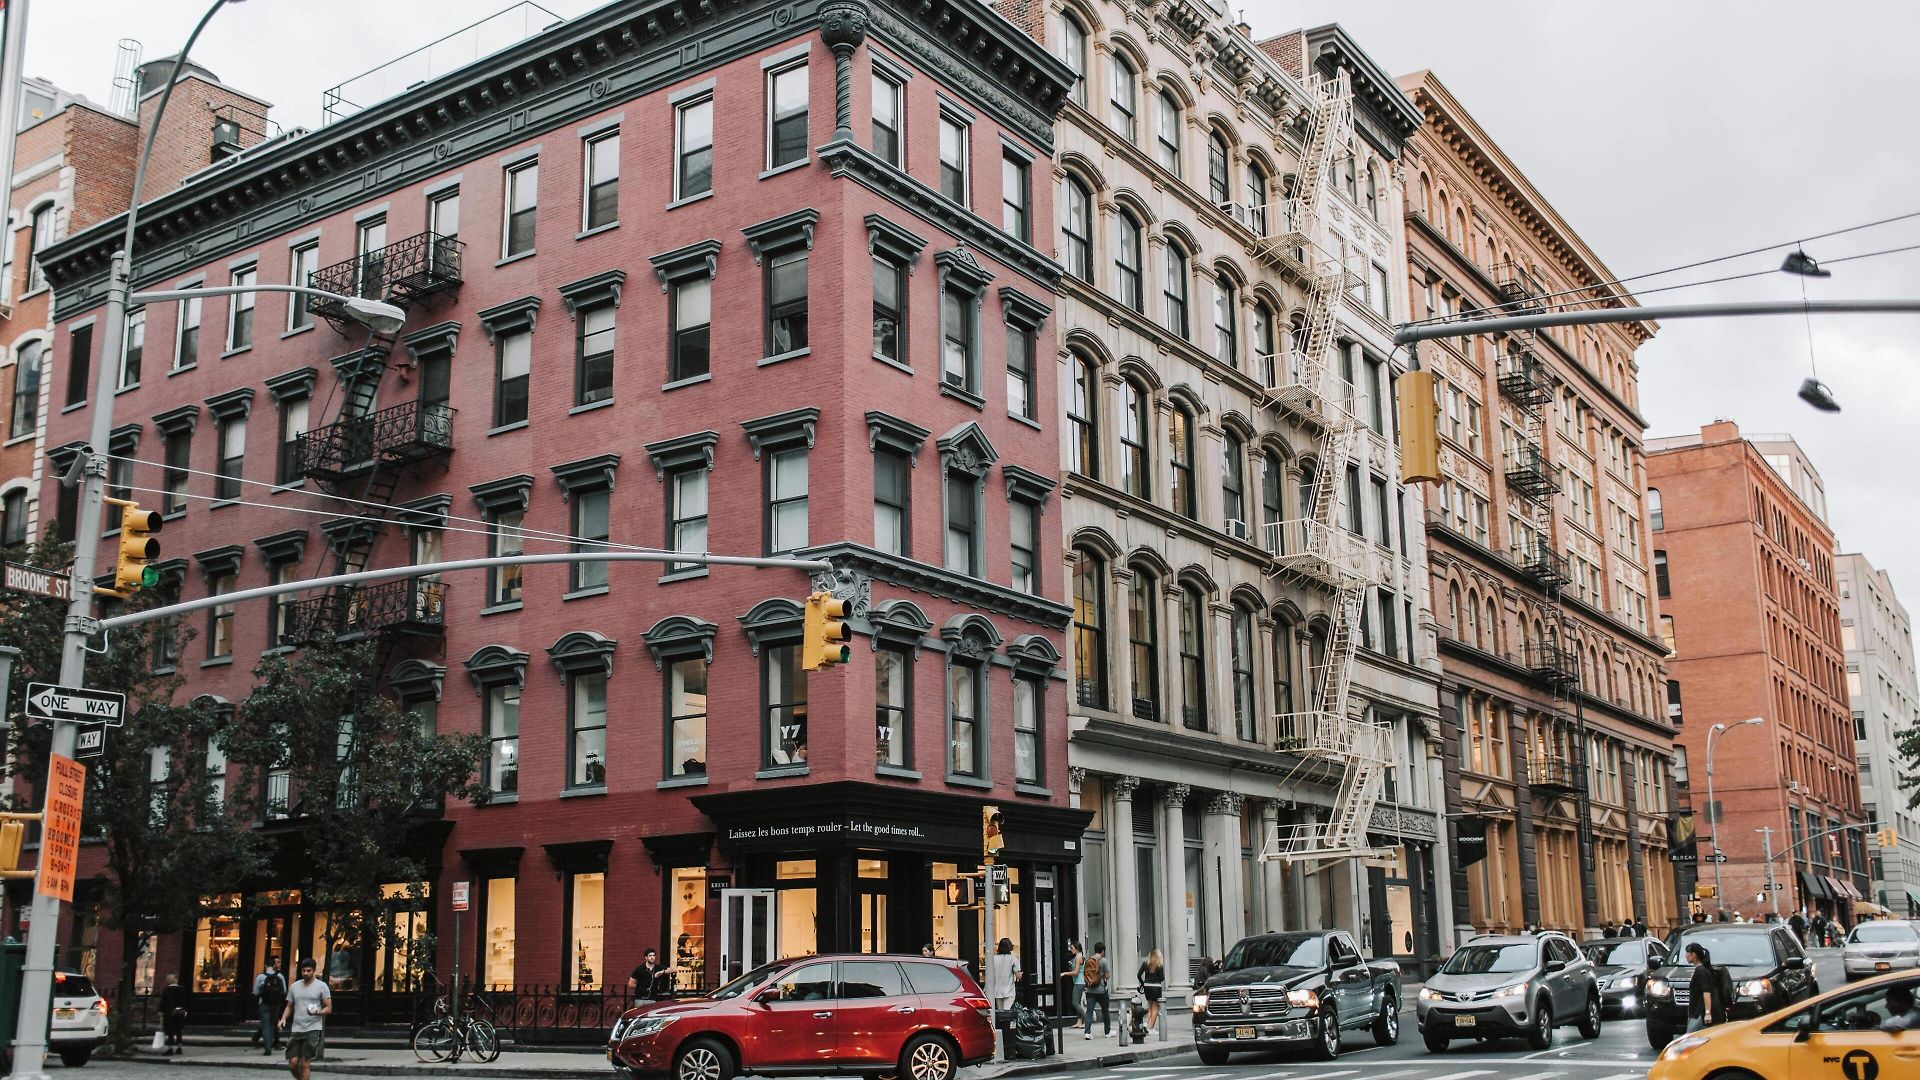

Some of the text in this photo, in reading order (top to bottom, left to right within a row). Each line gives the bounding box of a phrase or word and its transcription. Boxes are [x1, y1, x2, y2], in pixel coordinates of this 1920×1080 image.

[8, 567, 68, 599] BROOME ST
[41, 695, 116, 715] ONE WAY
[80, 732, 98, 747] WAY
[780, 724, 801, 739] Y7
[878, 725, 894, 740] Y7
[56, 761, 69, 778] FULL
[58, 782, 78, 801] CLOSURE
[729, 829, 756, 839] Laissez
[758, 827, 769, 837] les
[770, 826, 789, 836] bons
[791, 825, 815, 836] temps
[817, 821, 842, 833] rouler
[850, 820, 861, 831] Let
[862, 822, 873, 832] the
[873, 824, 890, 836] good
[890, 824, 908, 836] times
[908, 826, 925, 837] roll...
[50, 843, 72, 862] SPRING
[1849, 1056, 1870, 1080] T
